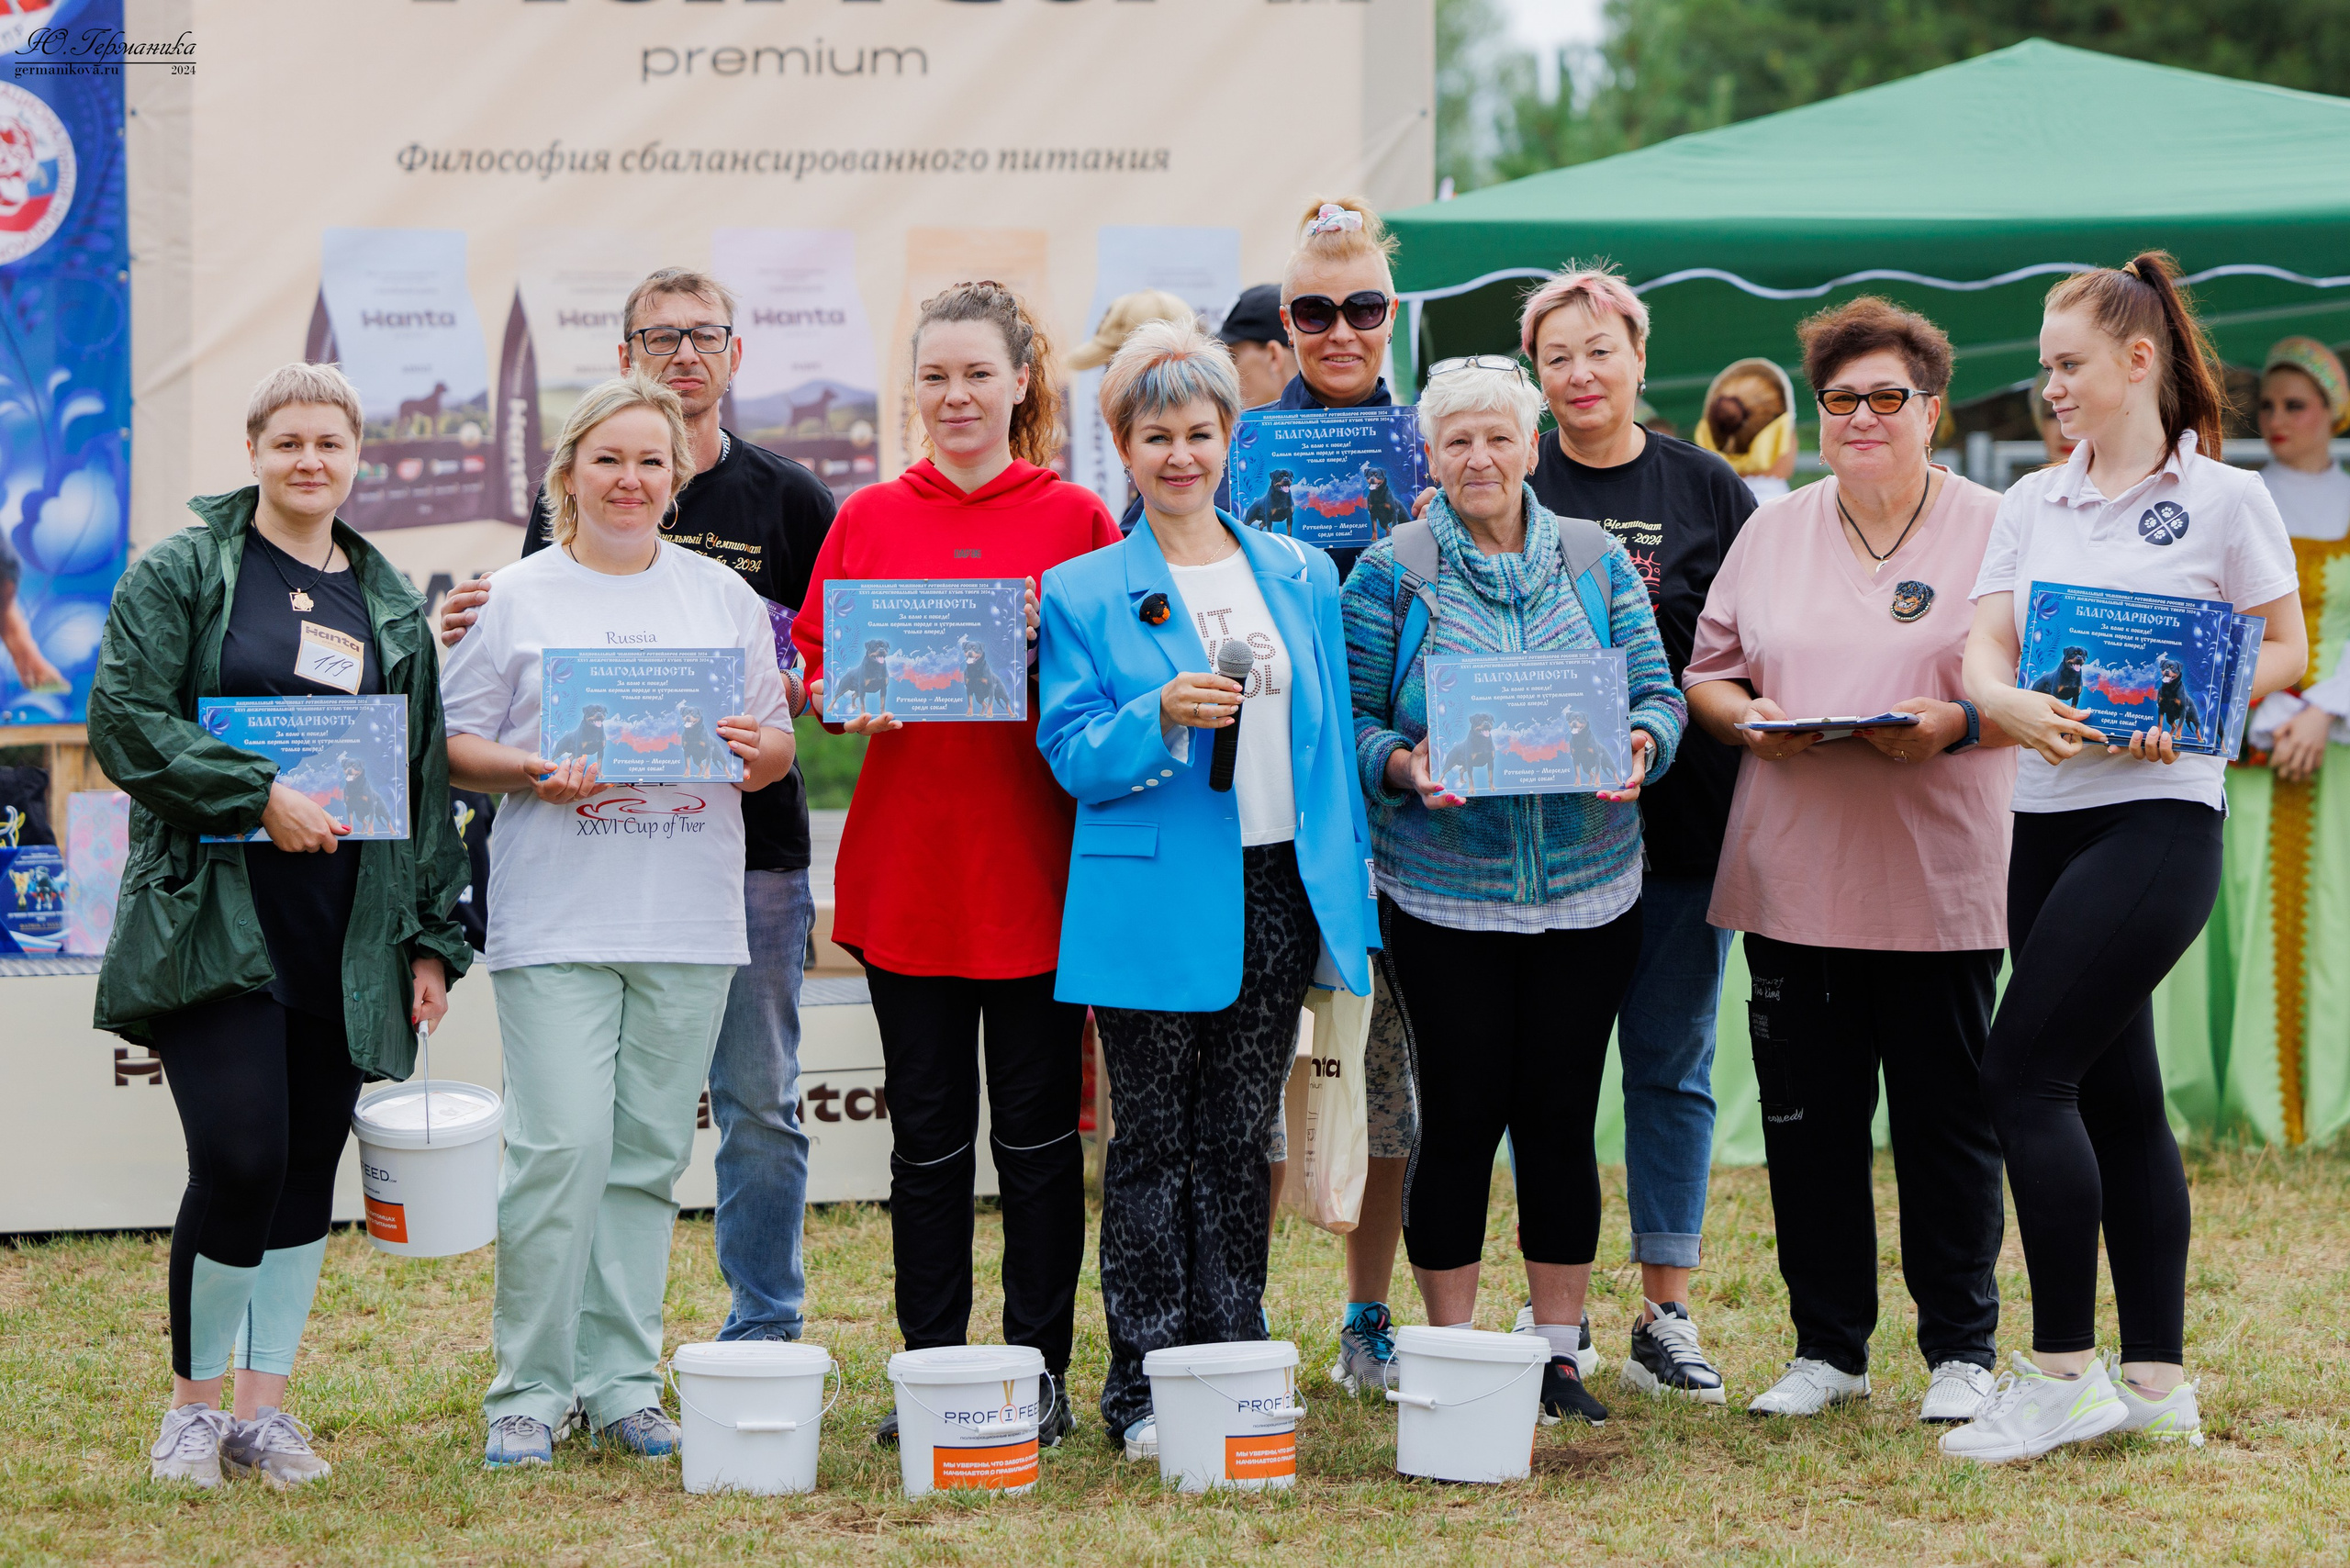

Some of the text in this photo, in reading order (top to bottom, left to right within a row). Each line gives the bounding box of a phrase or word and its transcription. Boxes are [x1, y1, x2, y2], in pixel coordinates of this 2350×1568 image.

[641, 38, 929, 83] premium
[396, 140, 1171, 182] Философия сбалансированного питания
[361, 308, 457, 329] Hanta
[752, 307, 845, 327] Hanta
[1274, 426, 1376, 441] БЛАГОДАРНОСТЬ
[1302, 522, 1332, 531] Ротвейлер
[1604, 518, 1662, 532] Чемпионат
[705, 532, 762, 554] Чемпионат
[872, 599, 976, 610] БЛАГОДАРНОСТЬ
[1197, 608, 1232, 638] IT
[2075, 604, 2180, 629] БЛАГОДАРНОСТЬ
[606, 631, 657, 644] Russia
[2130, 626, 2153, 635] победе!
[306, 626, 360, 653] Hanta
[2123, 640, 2146, 650] вперед!
[314, 655, 354, 677] 119
[589, 666, 694, 678] БЛАГОДАРНОСТЬ
[1473, 668, 1577, 684] БЛАГОДАРНОСТЬ
[1527, 699, 1549, 707] вперед!
[248, 715, 354, 728] БЛАГОДАРНОСТЬ
[2119, 718, 2137, 726] собак!
[2124, 711, 2154, 722] Мерседес
[301, 745, 324, 753] вперед!
[1503, 767, 1535, 776] Ротвейлер
[576, 813, 705, 839] XXVI Cup of Tver
